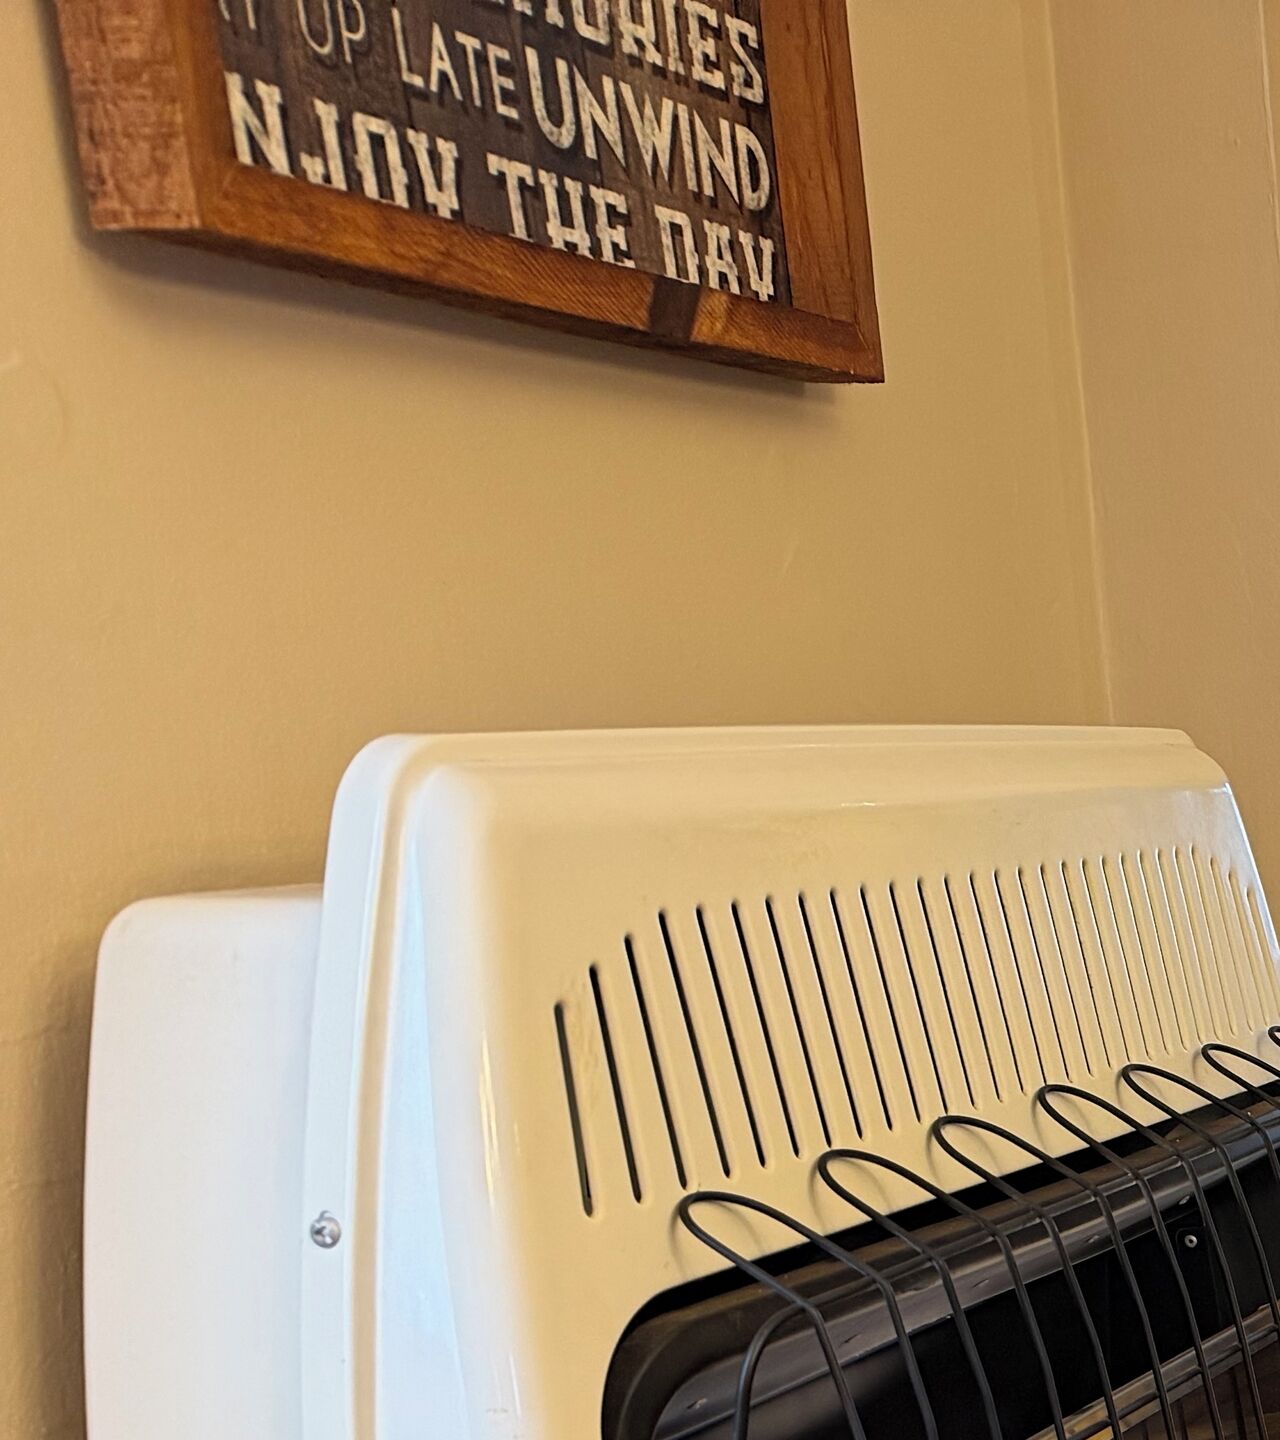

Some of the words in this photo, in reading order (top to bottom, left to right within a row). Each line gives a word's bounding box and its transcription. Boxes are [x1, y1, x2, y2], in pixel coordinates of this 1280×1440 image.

[297, 0, 366, 64] UP
[391, 7, 520, 120] LATE
[524, 45, 771, 212] UNWIND
[486, 152, 636, 269] THE
[653, 204, 774, 302] DAY
